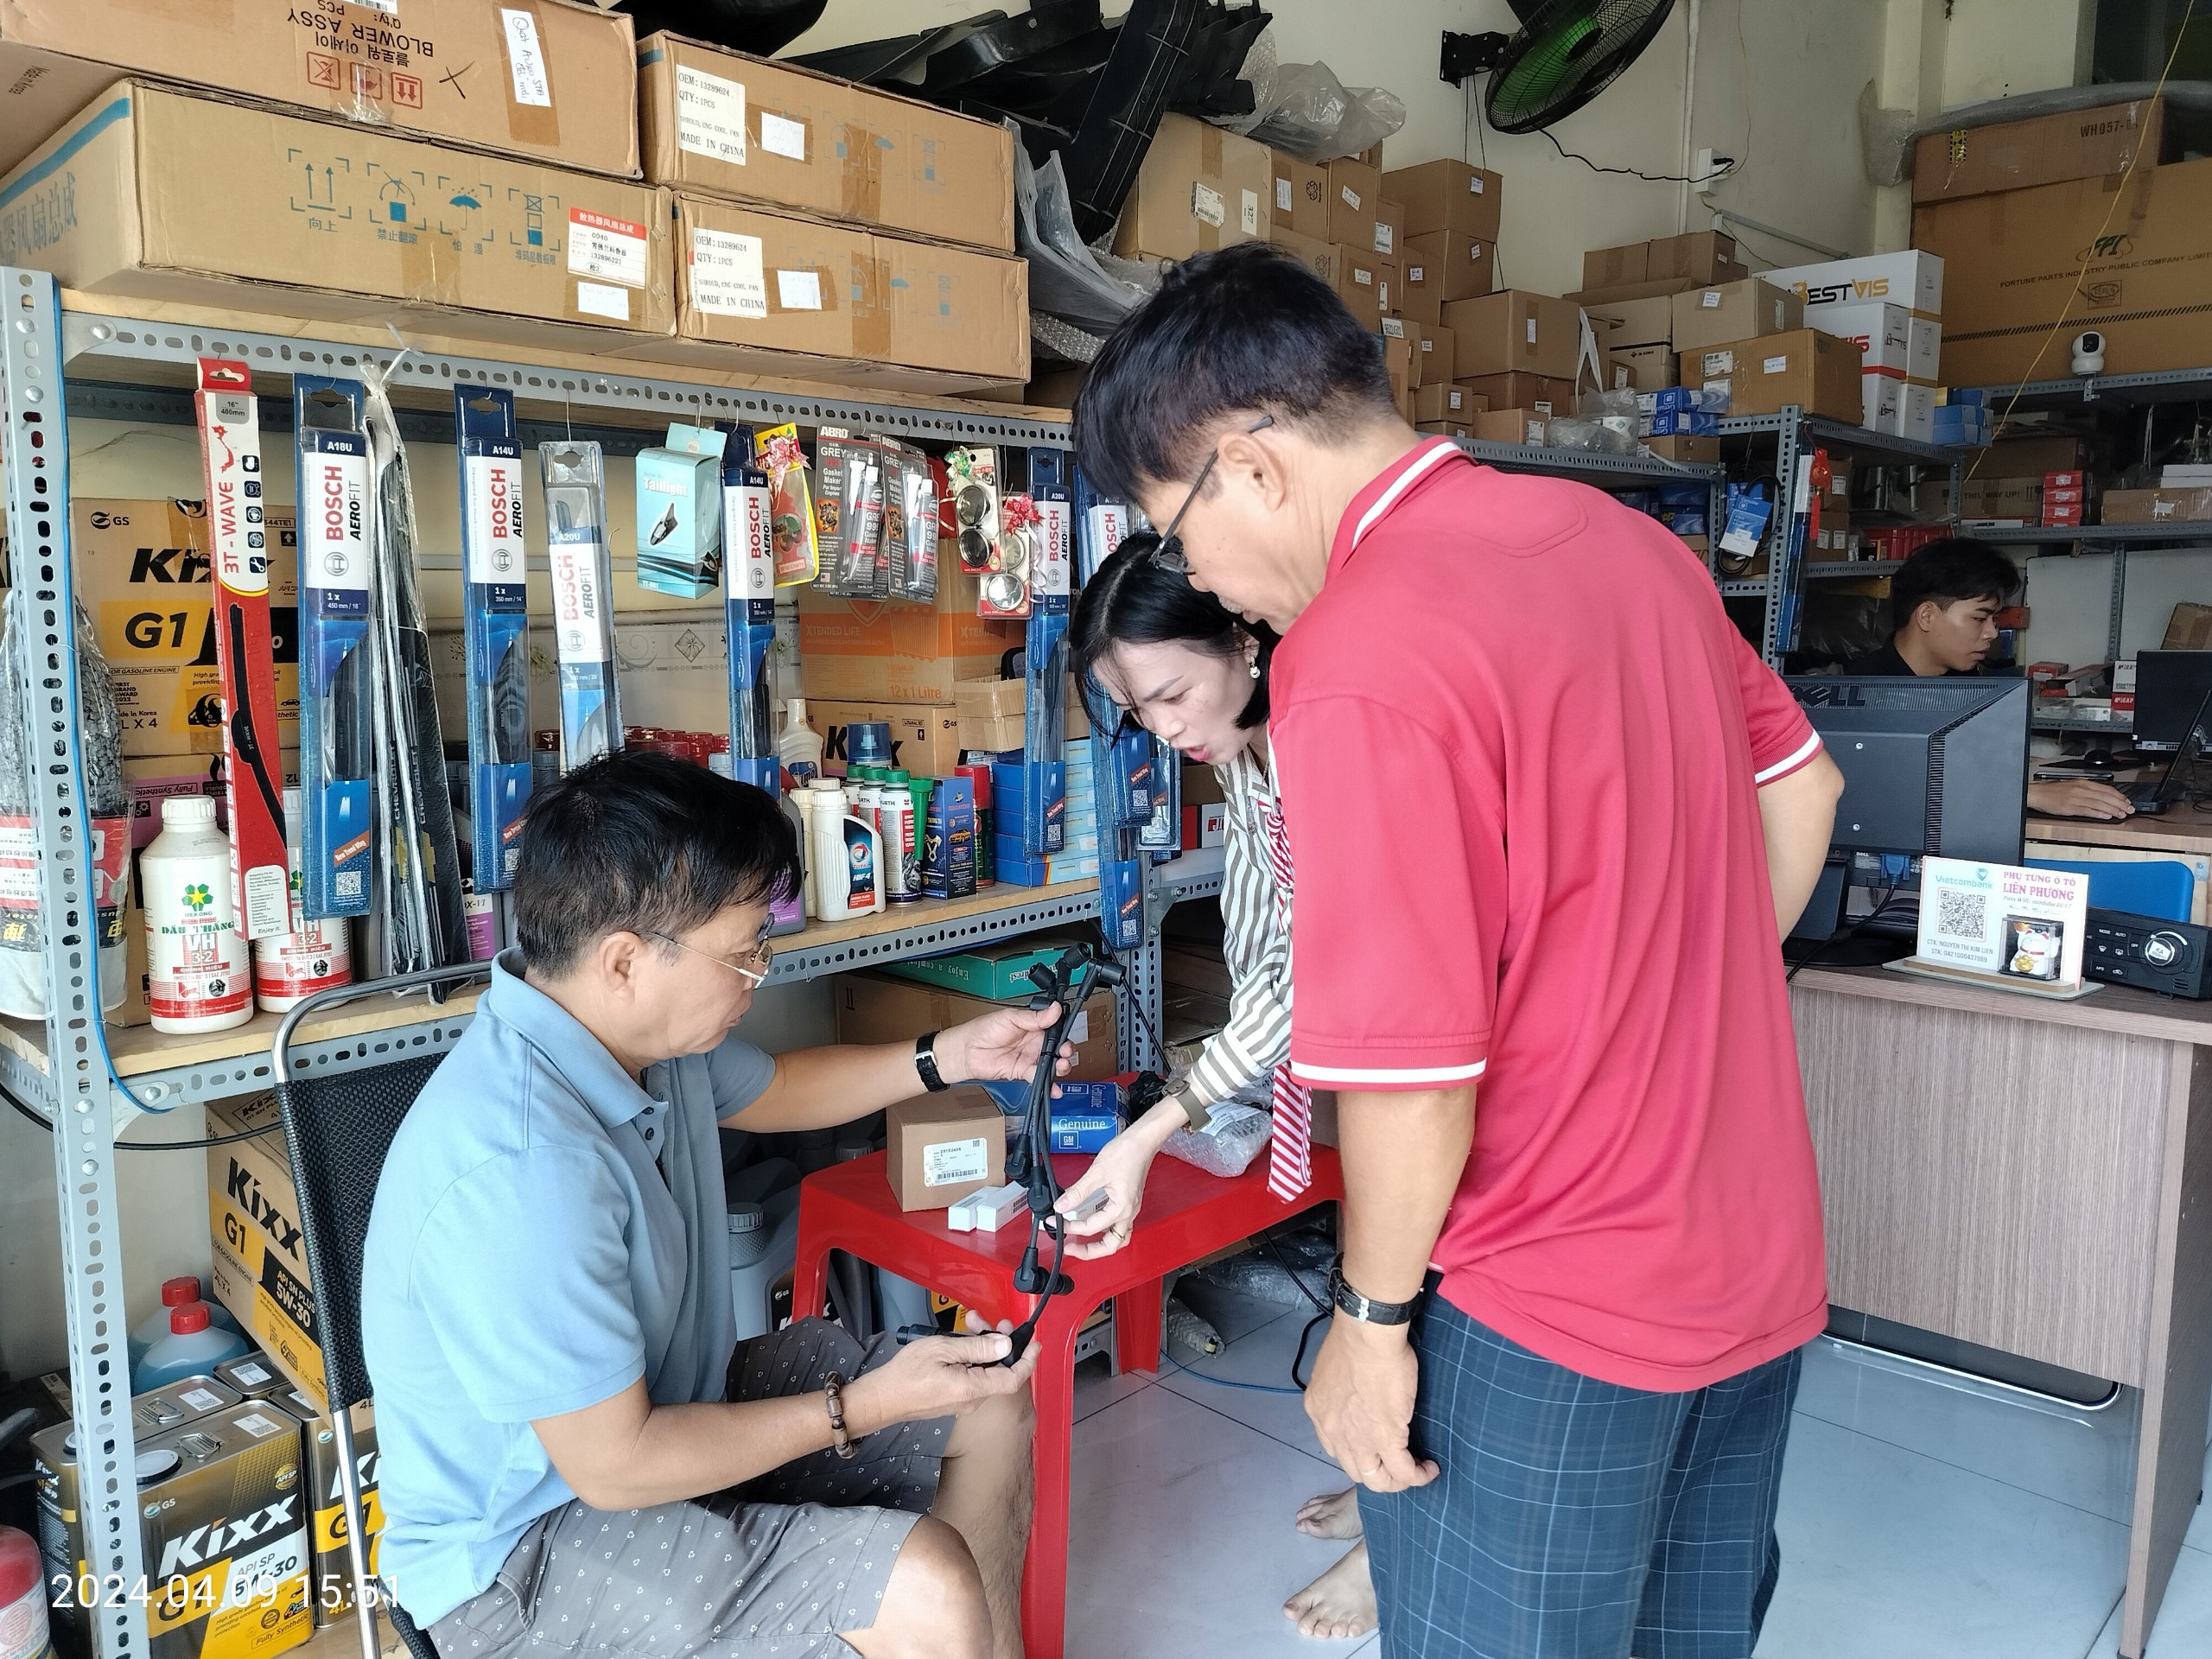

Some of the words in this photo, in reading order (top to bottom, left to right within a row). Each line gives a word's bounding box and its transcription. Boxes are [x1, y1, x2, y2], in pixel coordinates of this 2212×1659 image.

[288, 8, 342, 34] ASSY
[352, 22, 434, 58] BLOWER
[680, 130, 702, 146] MADE
[707, 138, 716, 149] IN
[720, 142, 745, 157] CHINA
[308, 218, 337, 232] 向上
[579, 212, 634, 234] 散热器风扇总成
[2000, 276, 2036, 288] FORTUNE
[2037, 272, 2063, 282] PARTS
[2065, 265, 2107, 278] INDSTRY
[2108, 262, 2139, 271] PUBLIC
[2142, 256, 2186, 268] COMPANY
[700, 294, 722, 307] MADE
[727, 297, 737, 307] IN
[741, 299, 765, 310] CHINA
[820, 426, 849, 439] ABRO
[327, 442, 353, 452] A18U
[493, 446, 513, 455] A14U
[821, 447, 846, 458] GREY
[882, 437, 902, 451] ABRO
[823, 467, 843, 477] Gasket
[885, 455, 902, 469] GREY
[644, 477, 688, 498] Taillight
[749, 476, 764, 485] A14U
[823, 476, 842, 485] Maker
[218, 481, 237, 537] WAVE
[324, 465, 344, 541] BOSCH
[347, 480, 362, 541] AEROFIT
[490, 468, 508, 538] BOSCH
[510, 481, 524, 538] AEROFIT
[113, 516, 130, 526] GS
[748, 497, 761, 559] BOSCH
[762, 508, 772, 558] AEROFIT
[1049, 510, 1059, 562] BOSCH
[1104, 513, 1118, 553] OSCH
[791, 561, 805, 570] Cherry
[557, 555, 579, 620] BOSCH
[579, 566, 595, 619] AEROFIT
[125, 612, 188, 649] G1
[805, 624, 842, 637] XTENDED
[843, 626, 861, 637] LIFE
[890, 685, 900, 697] 12
[901, 688, 908, 697] x
[918, 685, 942, 699] Litre
[136, 786, 172, 796] Synthetic
[174, 785, 194, 793] Fully
[390, 741, 401, 821] CHEVROLET
[410, 745, 426, 824] CHEVROLET
[334, 850, 346, 861] New
[345, 844, 356, 857] Trend
[356, 839, 366, 850] Wing
[1935, 874, 1993, 890] Vietcombank
[2003, 871, 2023, 881] PHỤ
[2024, 871, 2050, 884] TÙNG
[2063, 876, 2076, 887] TÔ
[2002, 881, 2027, 895] LIÊN
[2031, 885, 2075, 901] PHƯƠNG
[185, 933, 216, 951] VH
[298, 932, 317, 944] 3-2
[1970, 944, 1980, 952] KIM
[191, 951, 213, 963] 3-2
[1931, 948, 1944, 957] STK:
[1091, 1084, 1107, 1108] Genuine
[1059, 1118, 1106, 1129] Genuine
[1064, 1135, 1074, 1144] GM
[226, 1155, 302, 1262] Kixx
[224, 1211, 247, 1255] G1
[238, 1263, 253, 1287] ENGINE
[276, 1269, 289, 1288] API
[289, 1278, 299, 1297] SN
[298, 1285, 316, 1315] PLUS
[275, 1281, 312, 1329] 5W-30
[276, 1473, 287, 1484] API
[286, 1469, 297, 1479] SP
[162, 1497, 177, 1510] GS
[157, 1492, 298, 1580] Kixx
[258, 1552, 276, 1566] SP
[255, 1630, 275, 1645] Fully
[276, 1612, 311, 1636] Synthetic
